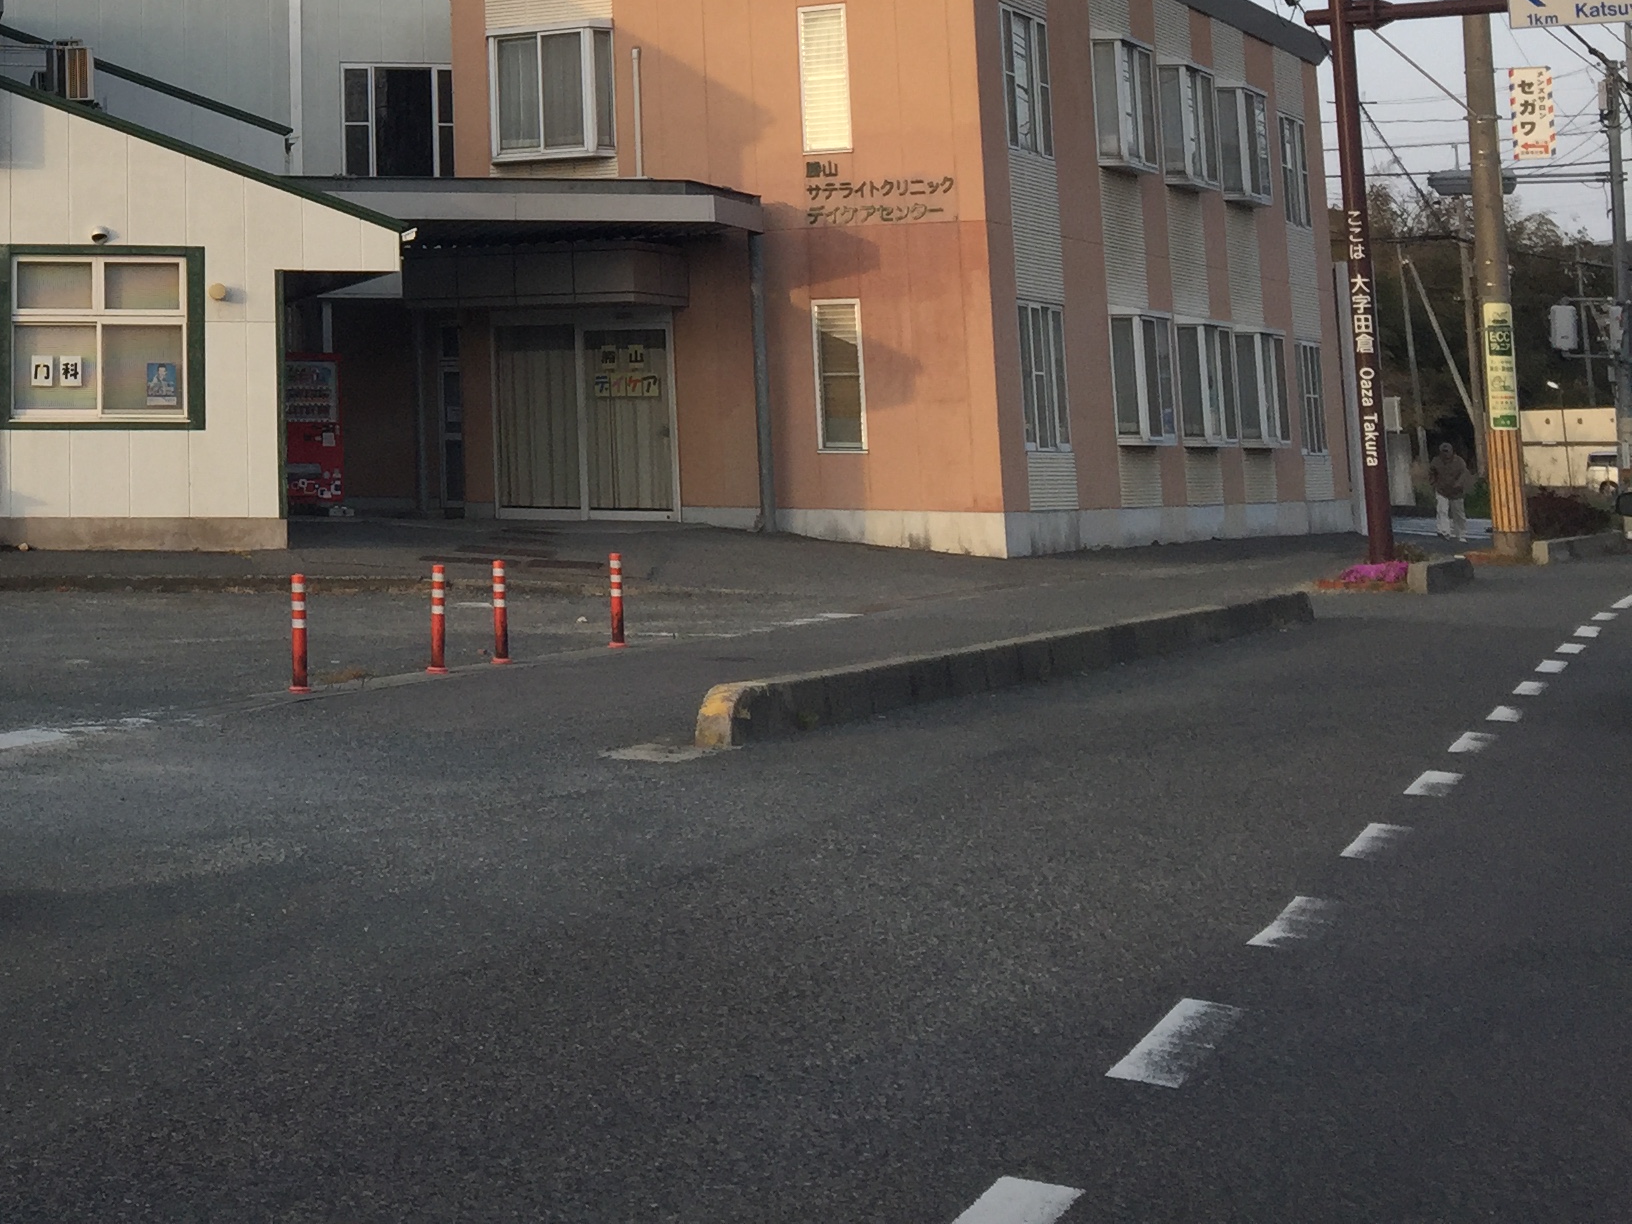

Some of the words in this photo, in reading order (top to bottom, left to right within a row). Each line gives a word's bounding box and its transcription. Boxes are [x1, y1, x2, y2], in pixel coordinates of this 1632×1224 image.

[1527, 14, 1559, 26] 1km
[1517, 80, 1537, 137] セガワ
[806, 176, 954, 201] サテライトクリニック
[1489, 331, 1510, 343] ECC
[1359, 367, 1375, 407] Oaza
[1363, 412, 1379, 467] Takura
